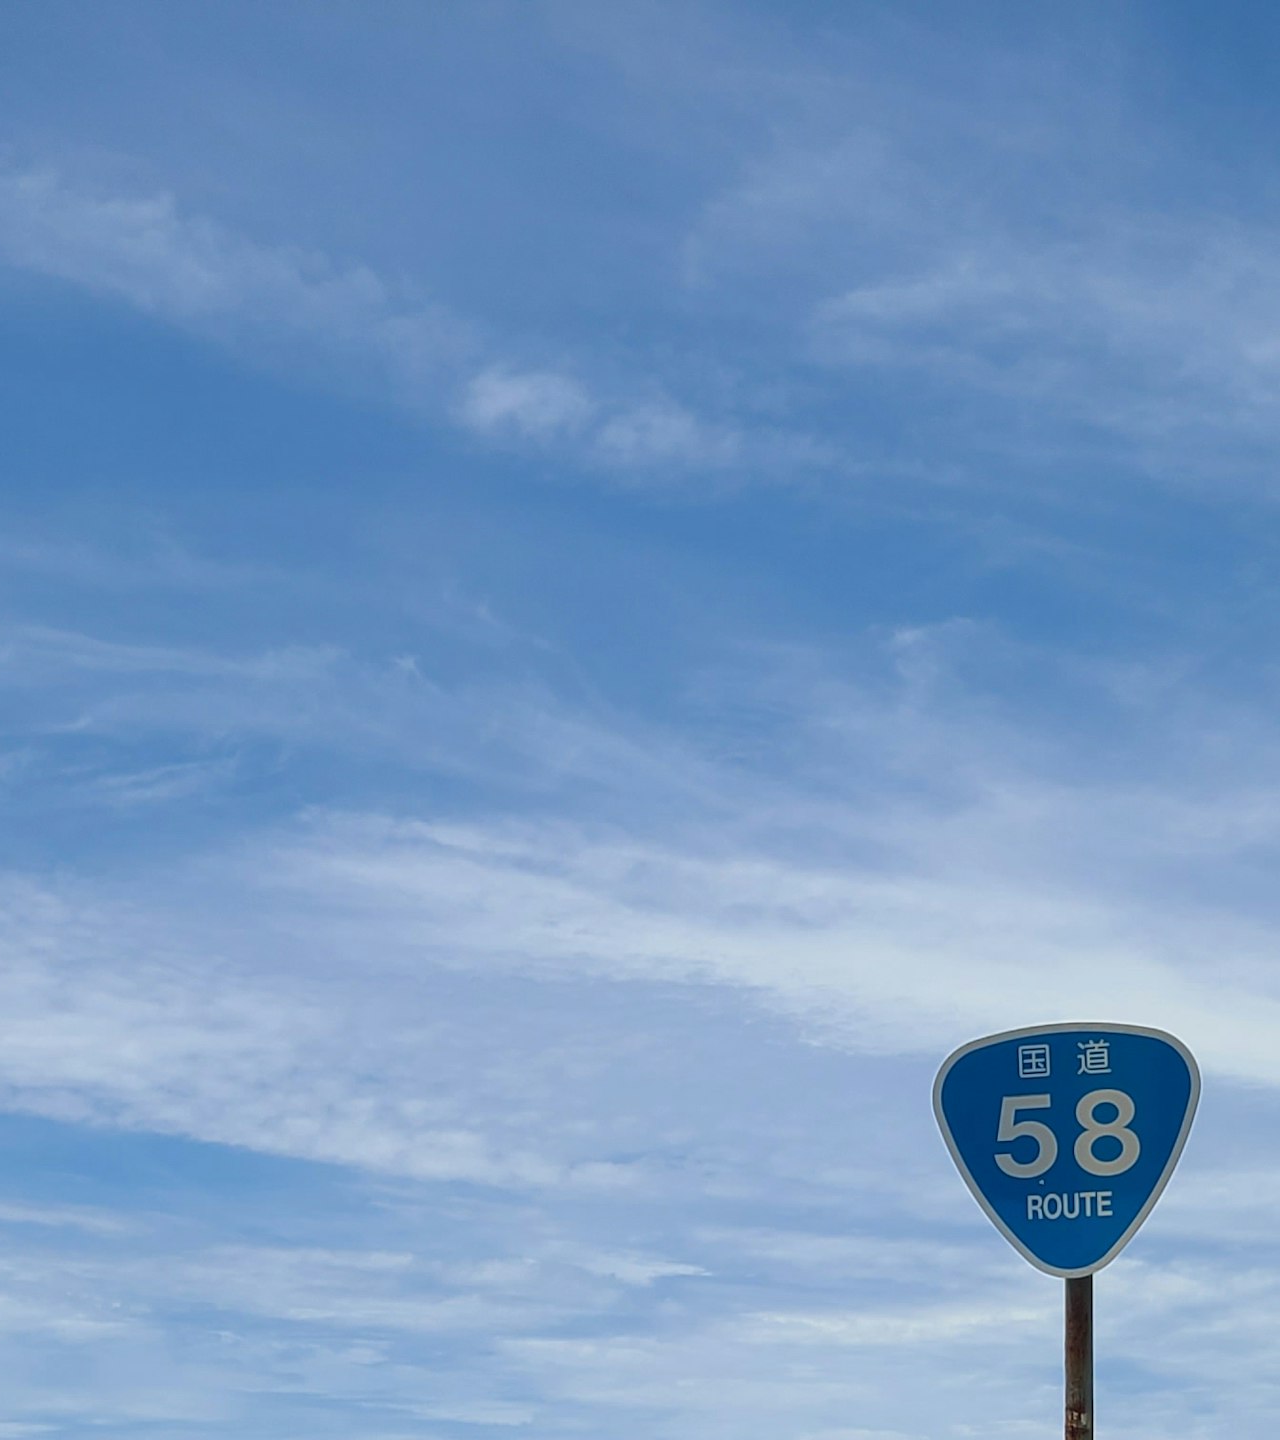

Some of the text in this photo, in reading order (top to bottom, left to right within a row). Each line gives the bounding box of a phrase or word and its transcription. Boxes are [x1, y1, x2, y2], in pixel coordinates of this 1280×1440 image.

[1017, 1039, 1112, 1078] 国道
[994, 1088, 1141, 1179] 58
[1027, 1191, 1113, 1220] ROUTE
